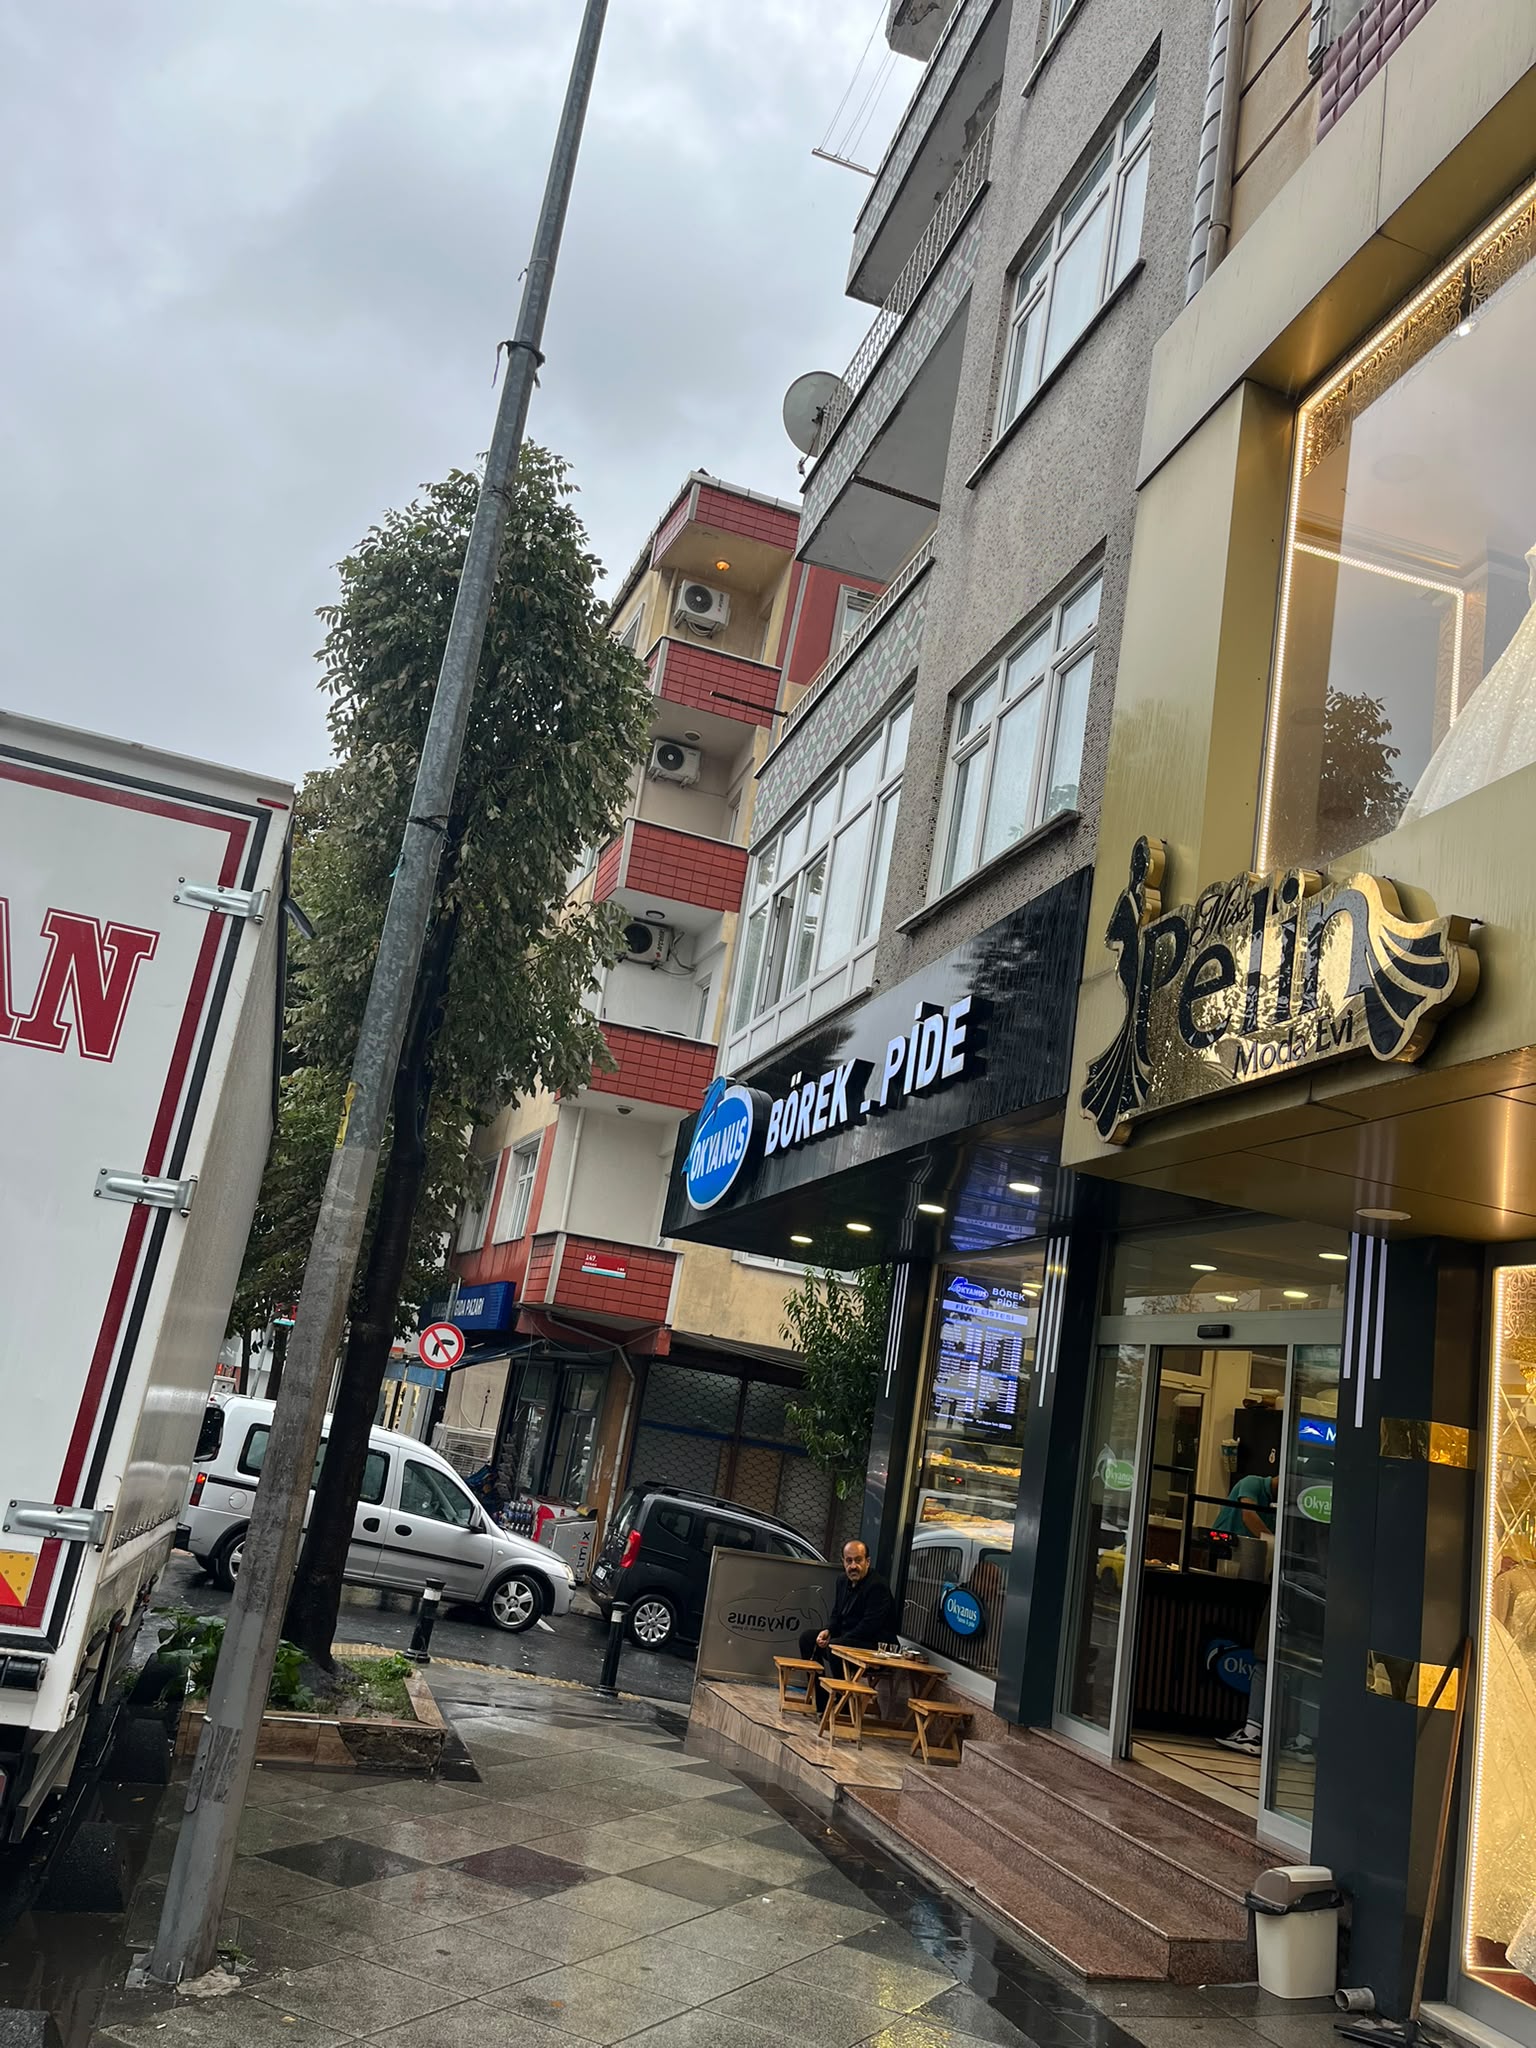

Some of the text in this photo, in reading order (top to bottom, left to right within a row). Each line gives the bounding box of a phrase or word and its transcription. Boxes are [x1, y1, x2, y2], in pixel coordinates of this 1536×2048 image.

[1191, 884, 1252, 946] Miss
[1137, 876, 1377, 1068] Pelin
[764, 1058, 857, 1157] BÖREK
[880, 995, 972, 1107] PİDE
[1231, 1011, 1354, 1080] Moda Evi
[690, 1115, 748, 1182] OKYANUS
[947, 1598, 977, 1622] Okyanus
